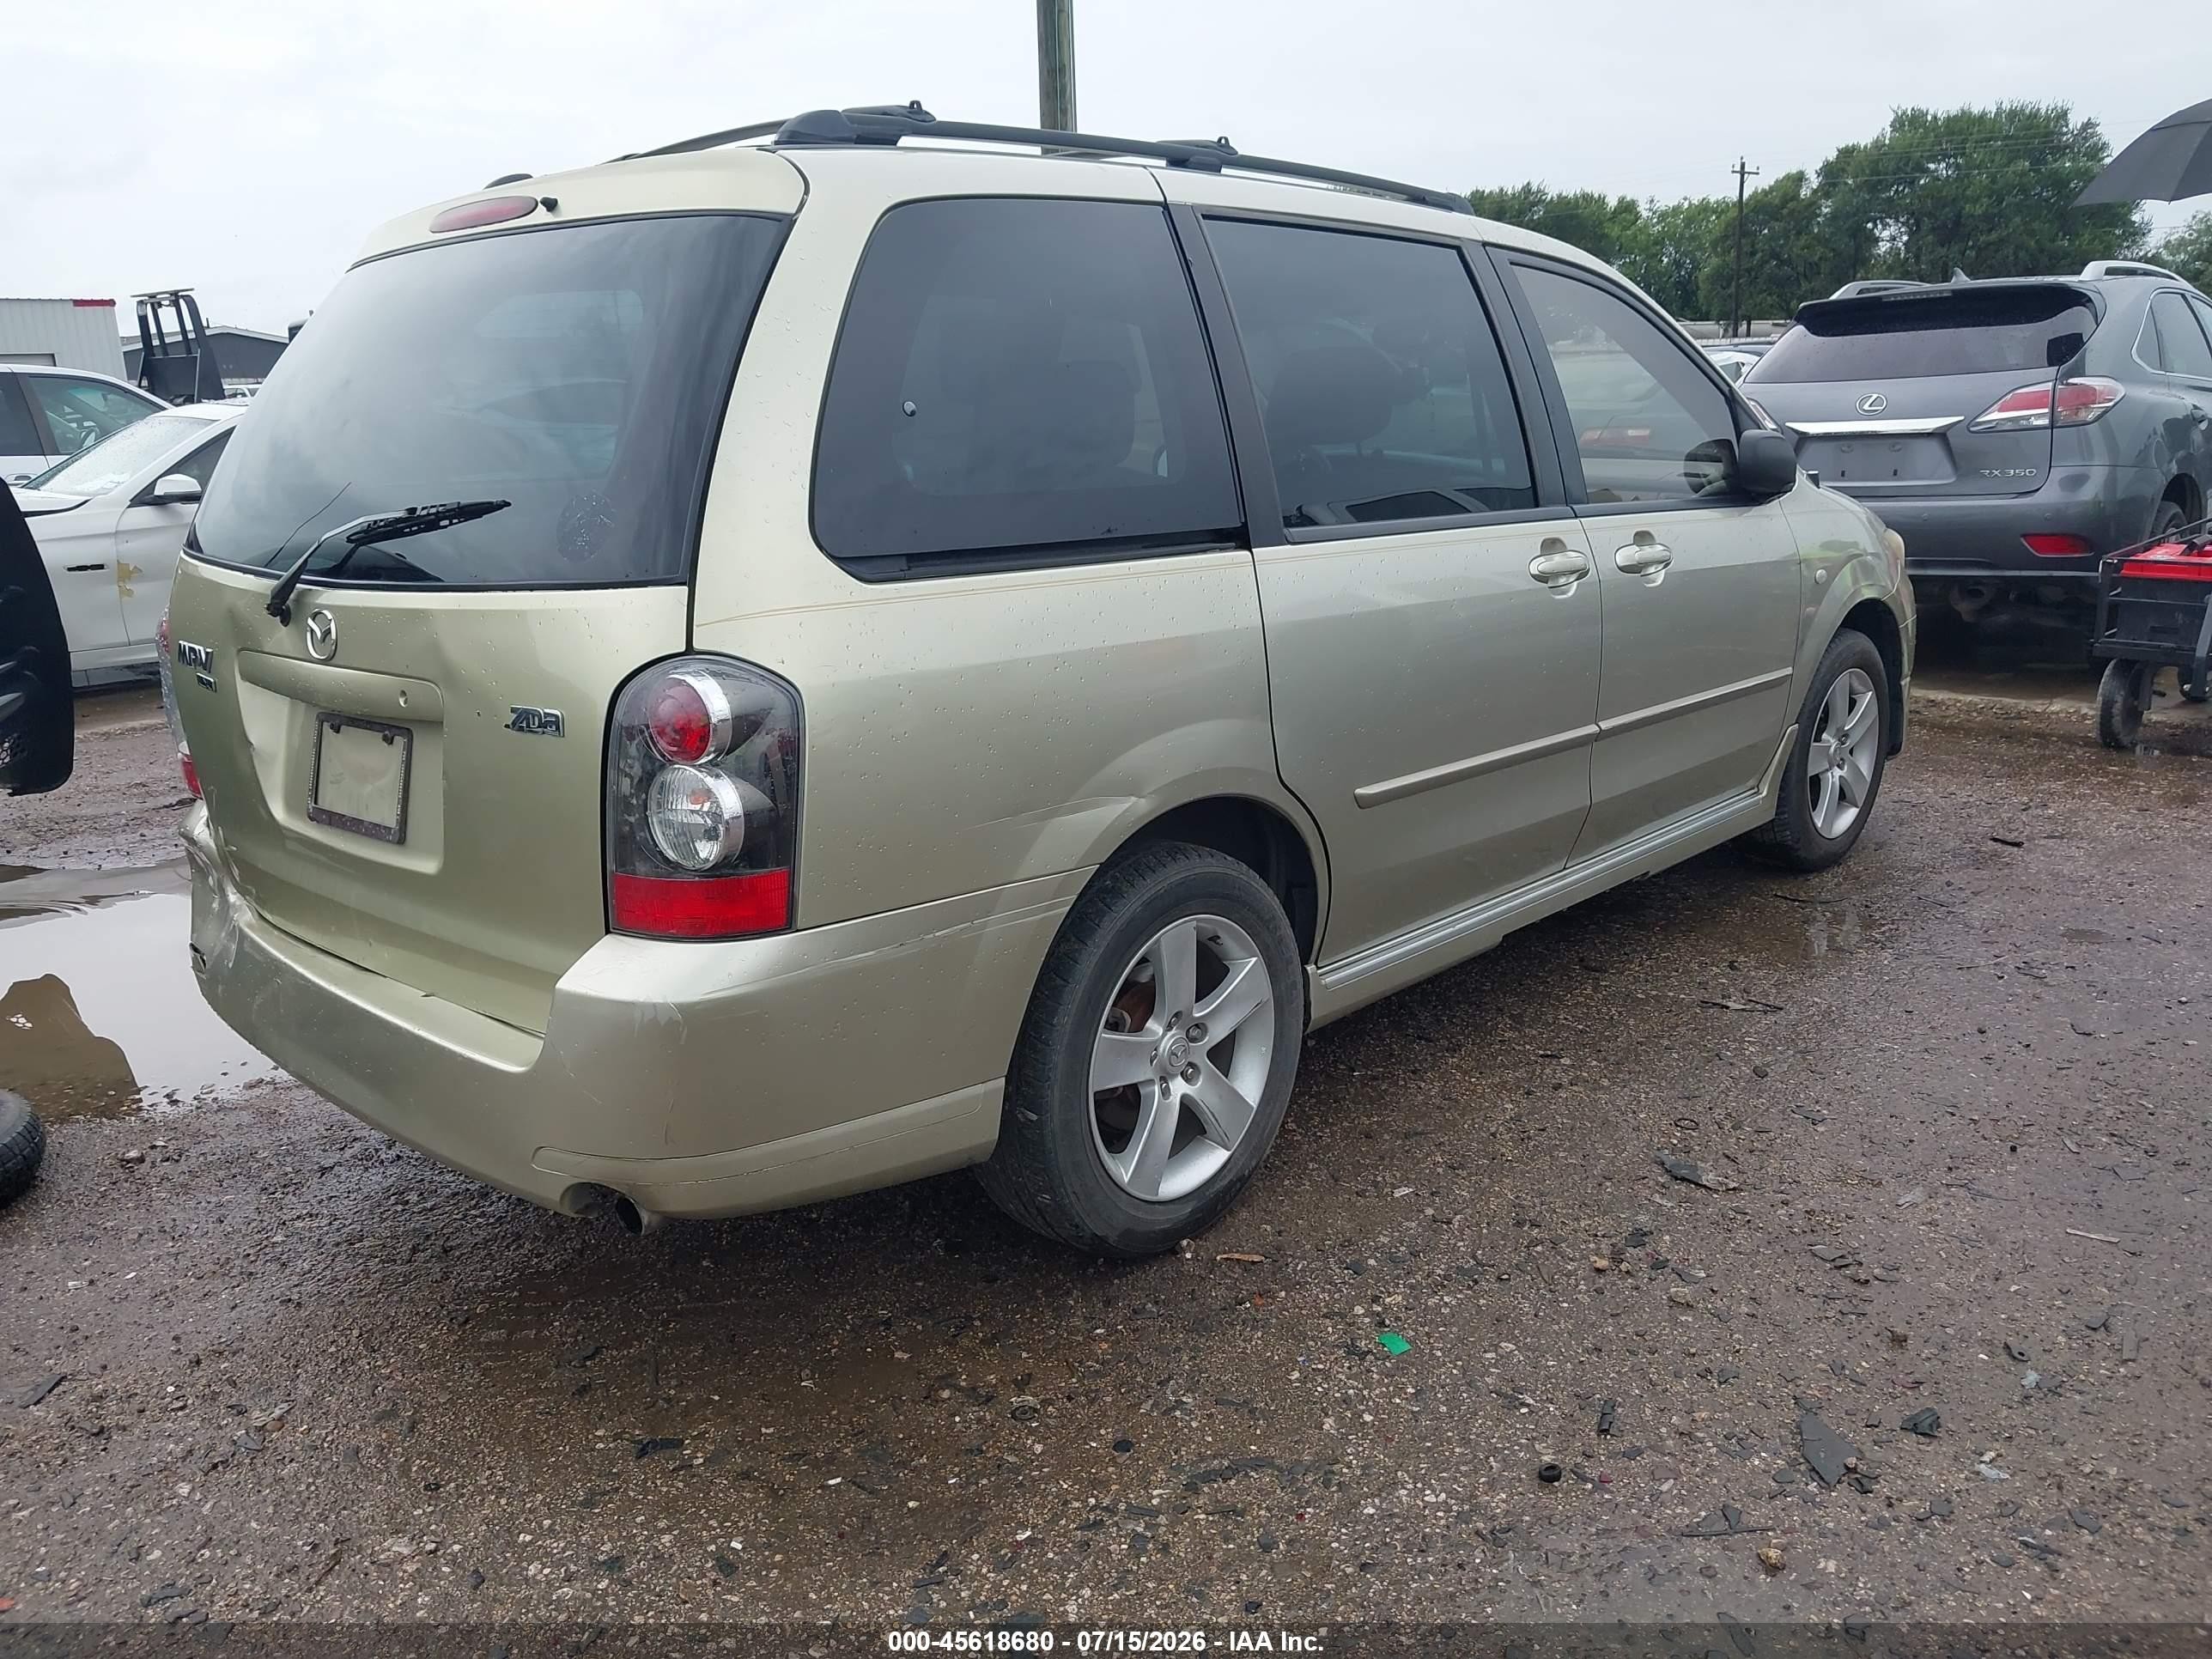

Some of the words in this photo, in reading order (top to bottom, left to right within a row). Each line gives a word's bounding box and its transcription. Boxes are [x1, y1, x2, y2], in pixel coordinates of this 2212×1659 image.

[1978, 469, 2002, 477] RX
[2004, 468, 2037, 477] 350
[178, 640, 214, 674] MPV
